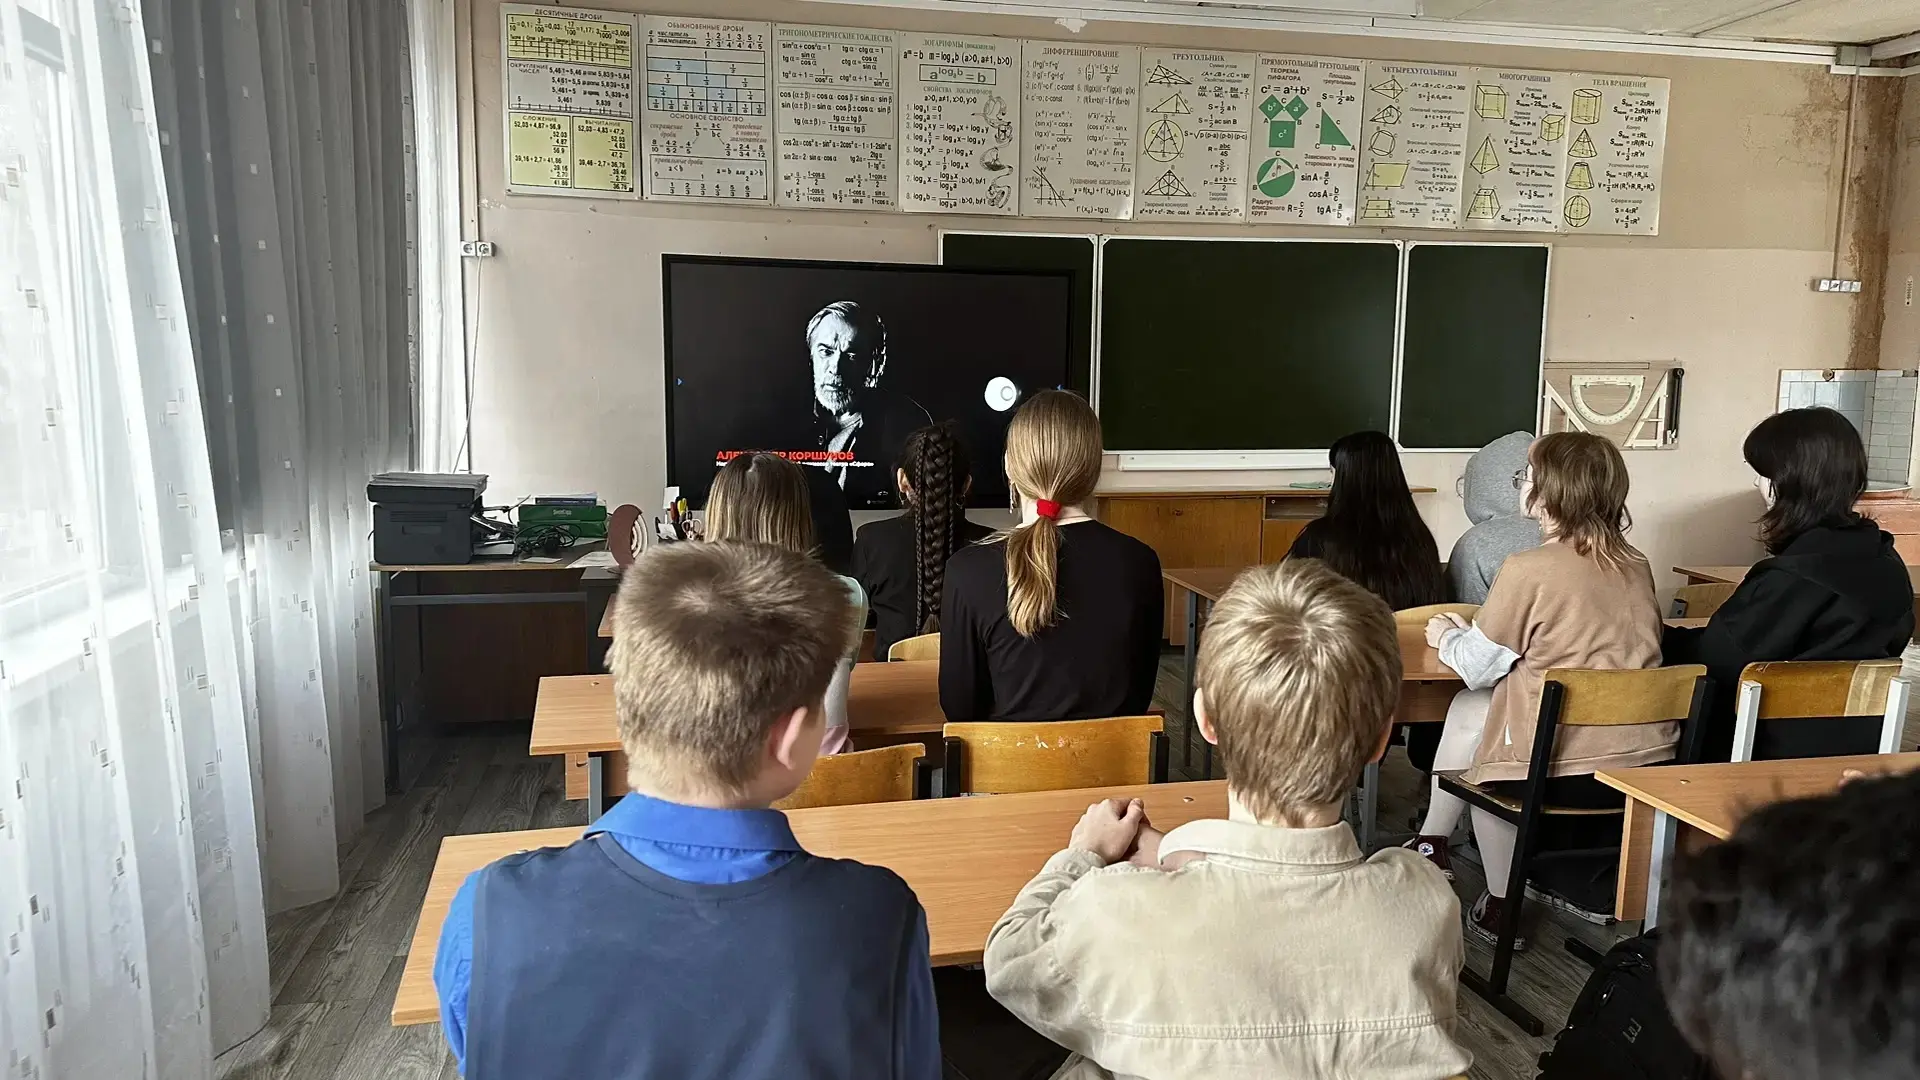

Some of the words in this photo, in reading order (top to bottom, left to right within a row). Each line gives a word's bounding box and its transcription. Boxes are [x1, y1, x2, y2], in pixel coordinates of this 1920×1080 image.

[534, 9, 578, 18] ДЕСЯТИЧНЫЕ
[668, 22, 720, 30] ОБЫКНОВЕННЫЕ
[779, 29, 855, 40] ТРИГОНОМЕТРИЧЕСКИЕ
[856, 32, 892, 42] ТОЖДЕСТВА
[923, 39, 963, 48] ЛОГАРИФМЫ
[1042, 48, 1119, 58] ДИФФЕРЕНЦИРОВАНИЕ
[1172, 54, 1224, 62] ТРЕУГОЛЬНИК
[1262, 58, 1318, 68] ПРЯМОУГОЛЬНЫЙ
[1319, 61, 1360, 72] ТРЕУГОЛЬНИК
[1382, 66, 1457, 76] ЧЕТЫРЕХУГОЛЬНИКИ
[1499, 73, 1550, 82] МНОГОГРАННИКИ
[788, 452, 854, 460] КОРШУНОВ
